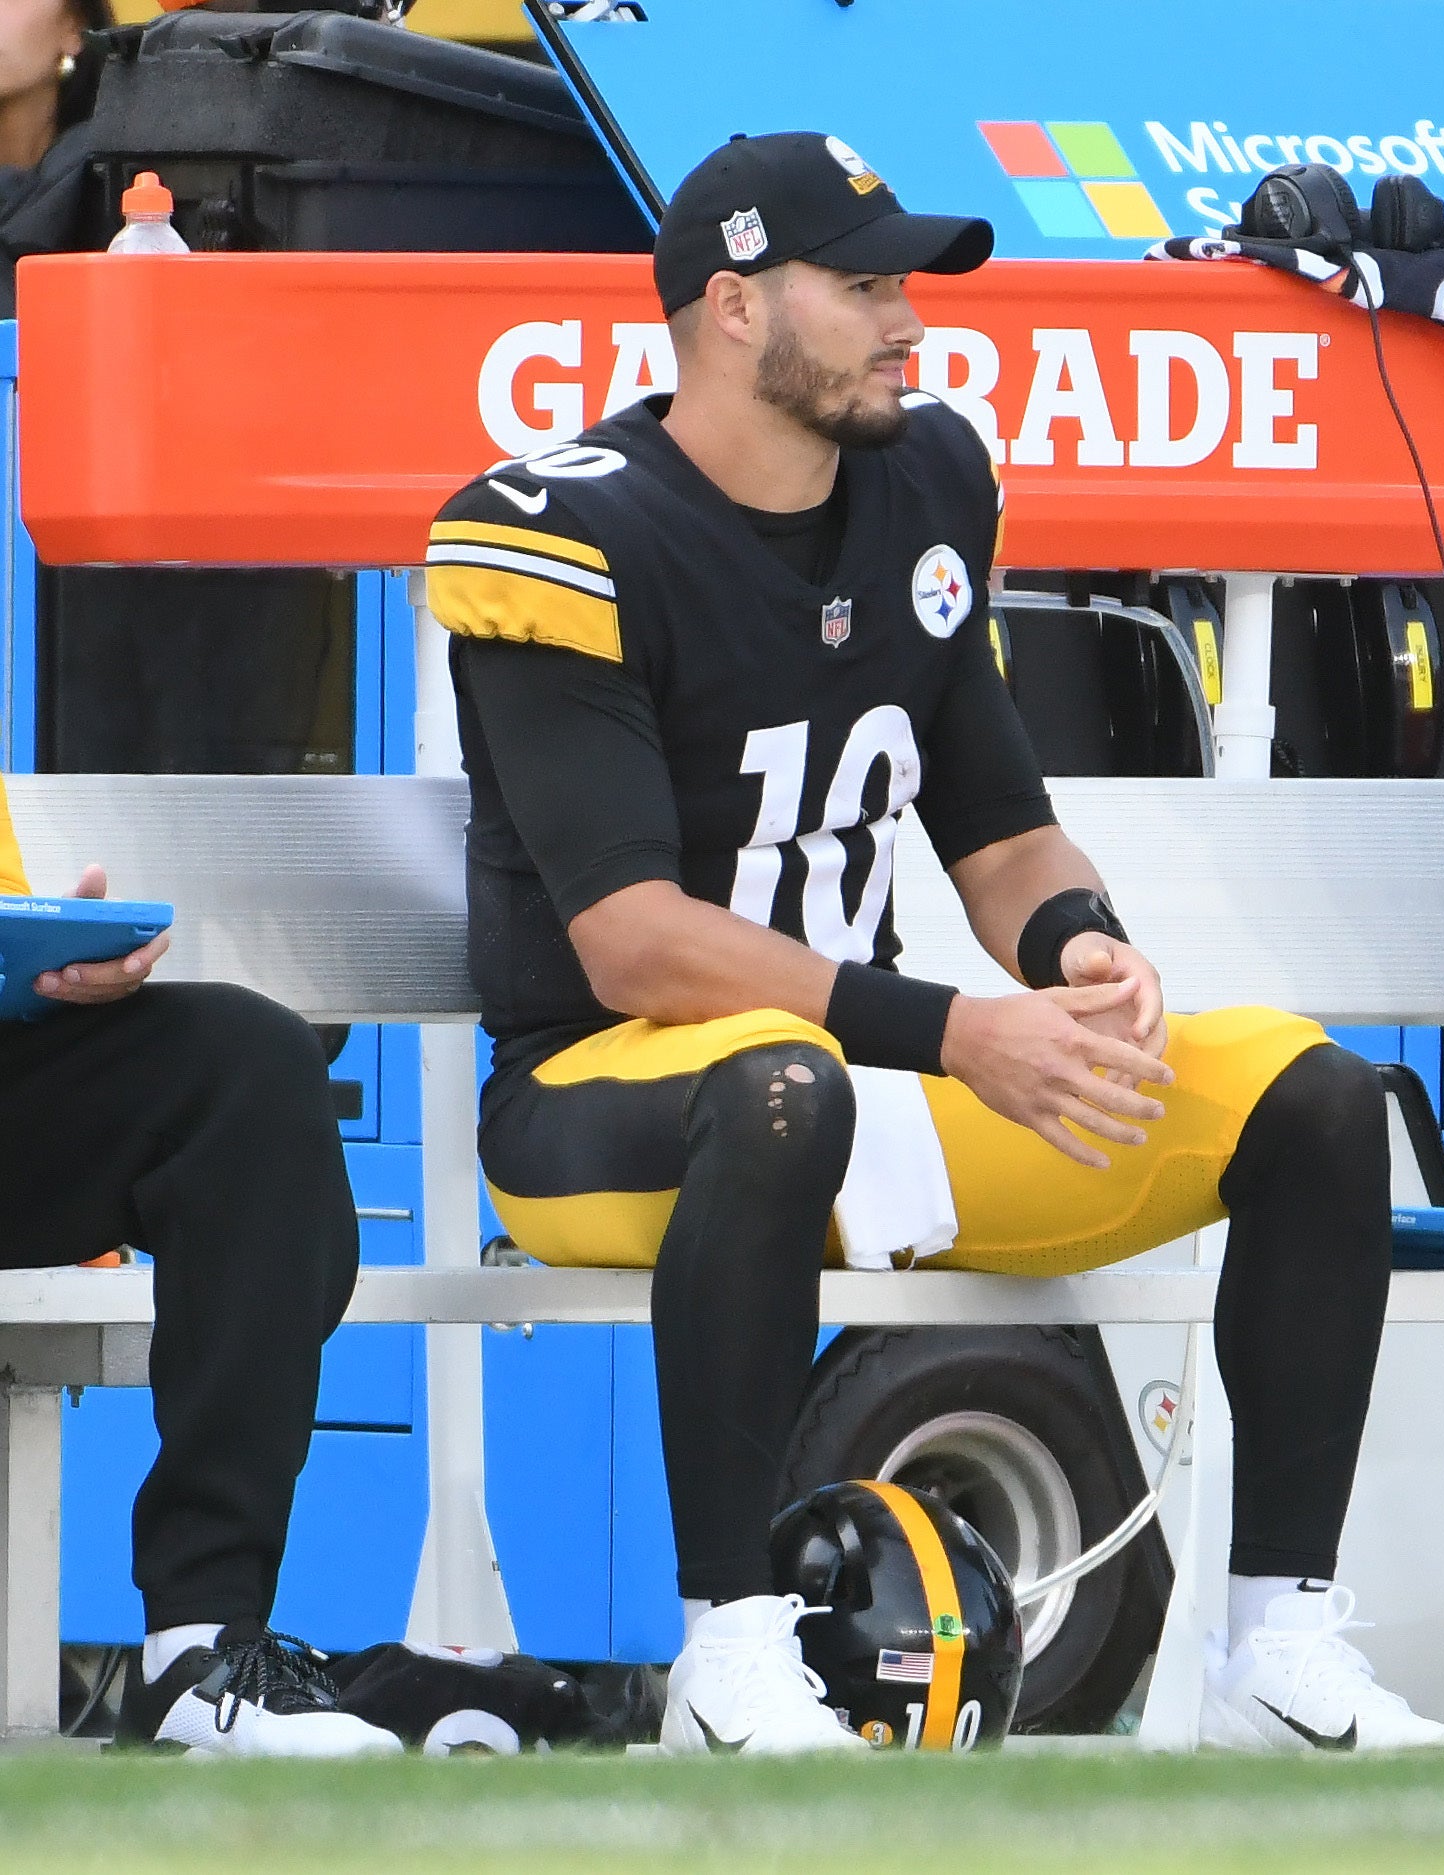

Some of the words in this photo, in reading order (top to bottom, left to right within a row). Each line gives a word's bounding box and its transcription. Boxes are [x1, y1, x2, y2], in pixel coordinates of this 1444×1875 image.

[732, 228, 761, 253] NFL
[478, 319, 1318, 468] GARADE
[730, 705, 922, 964] 10
